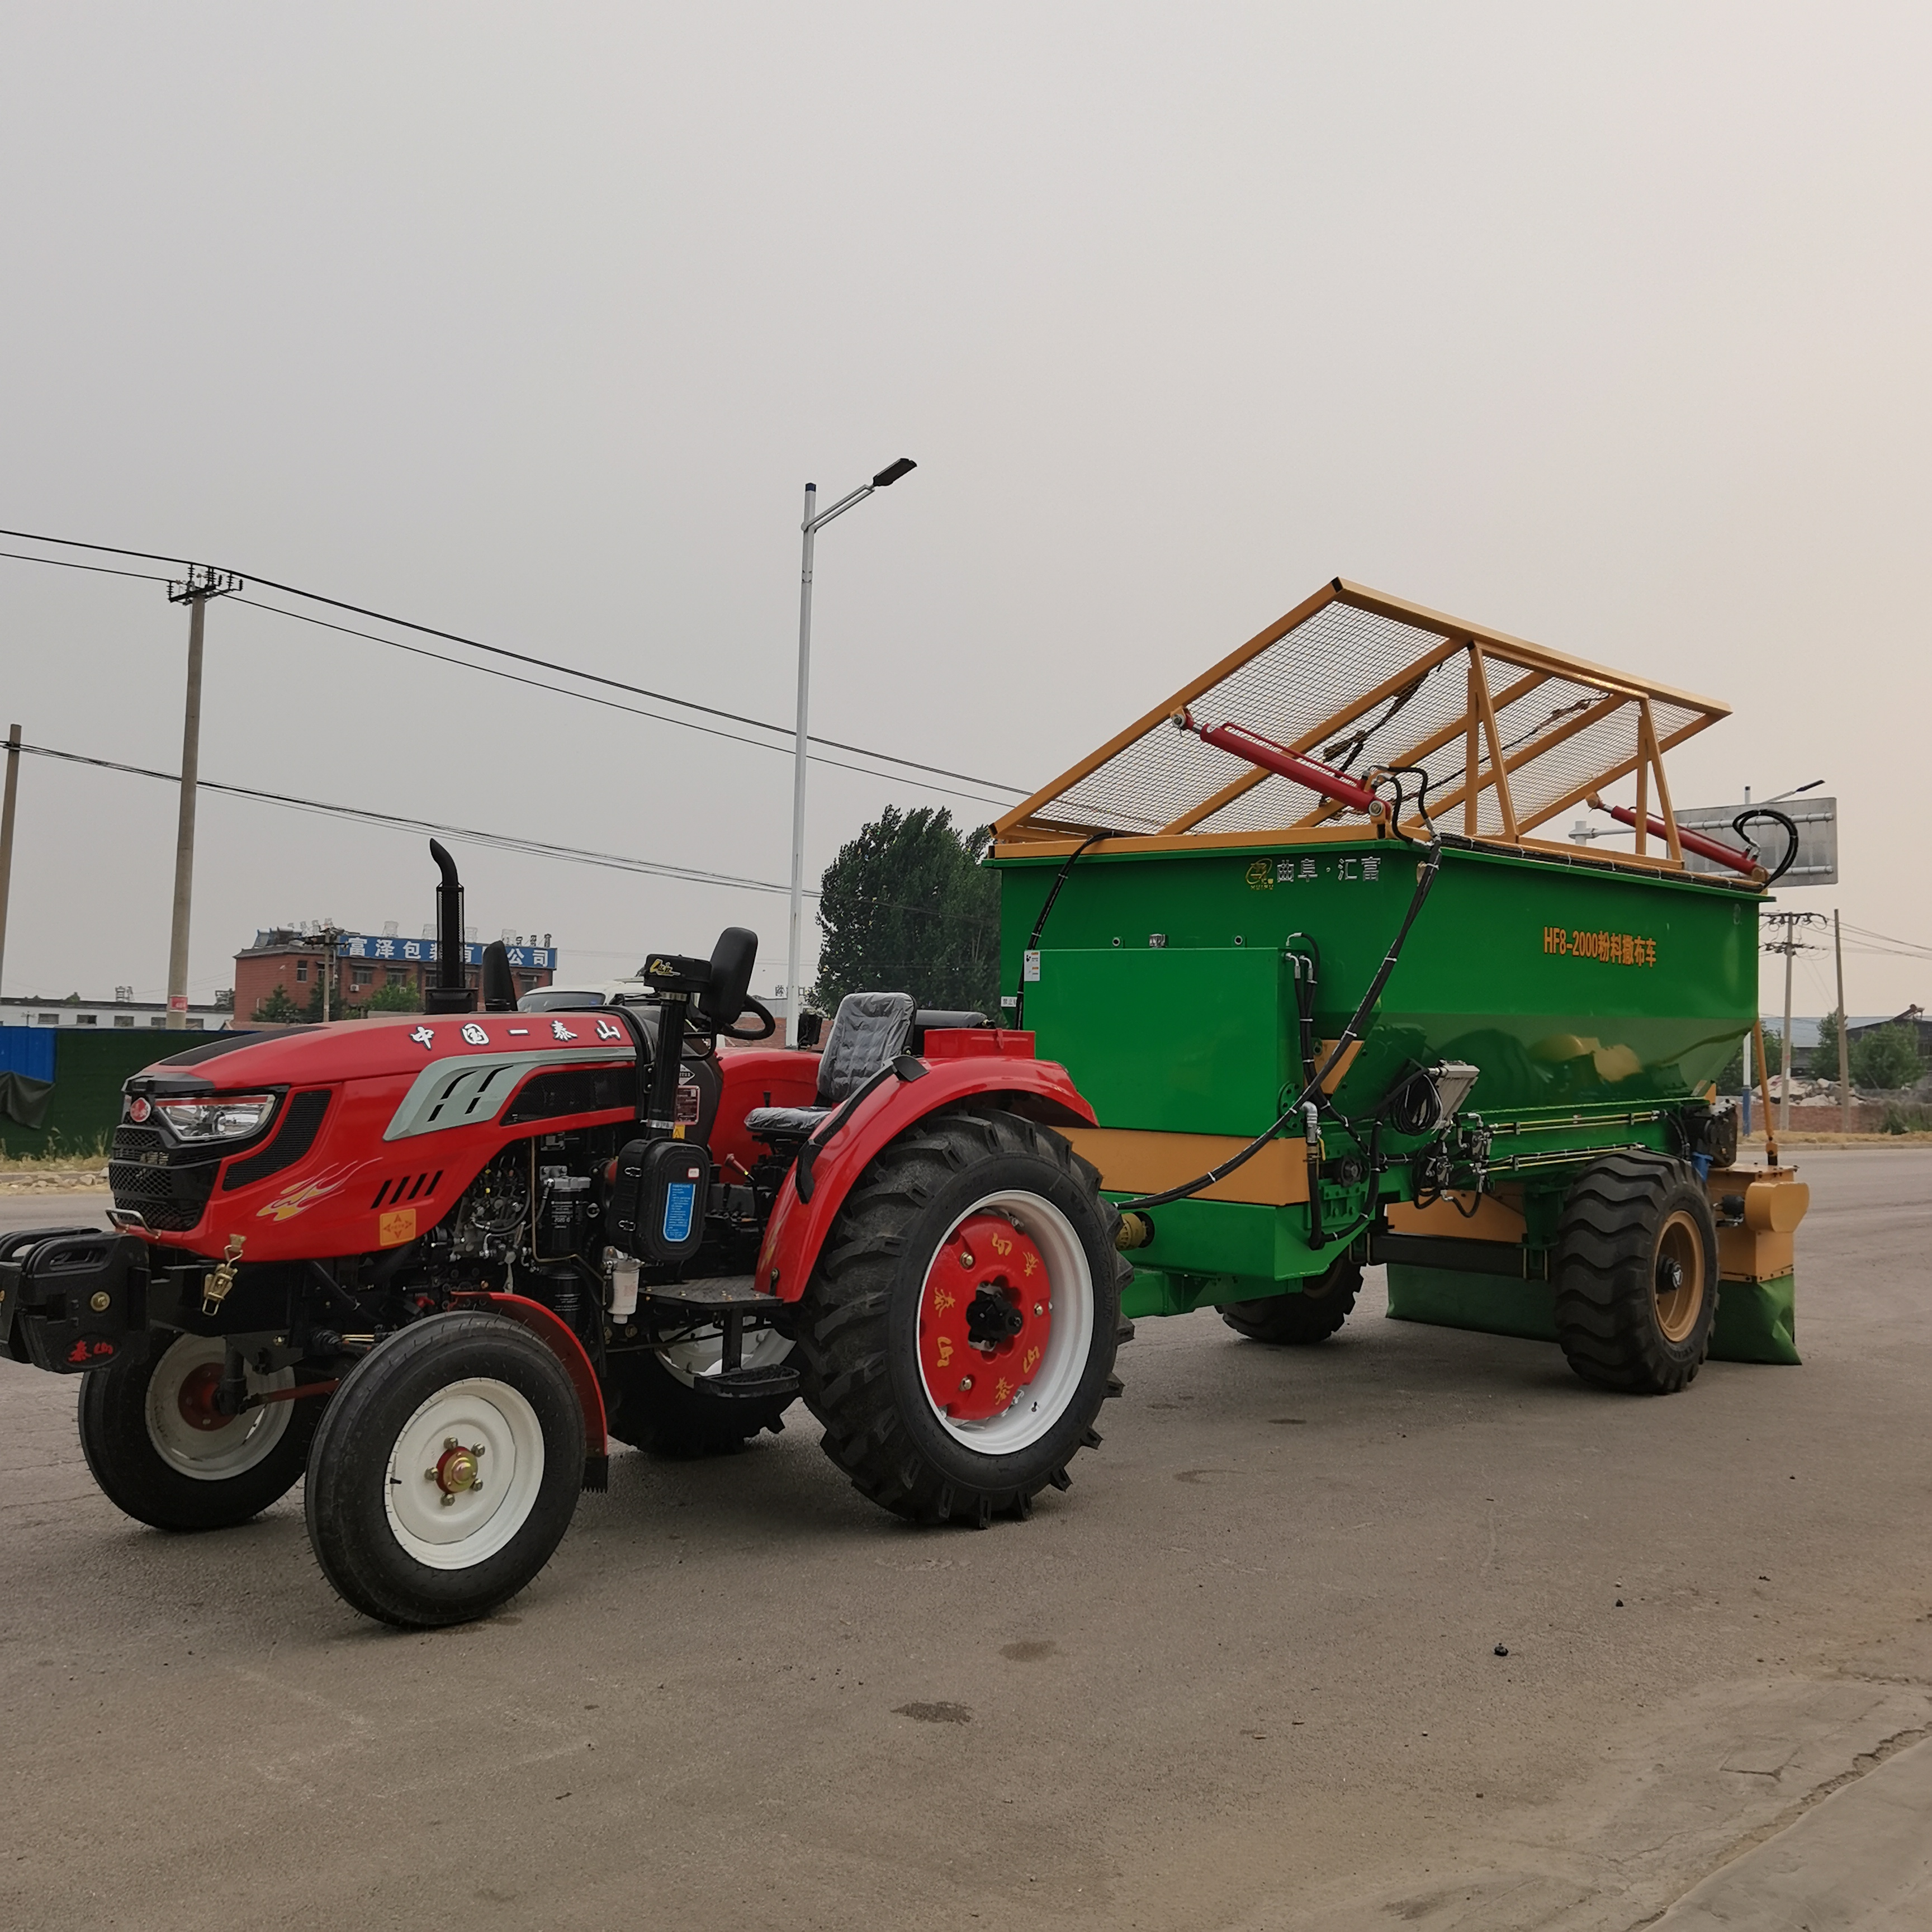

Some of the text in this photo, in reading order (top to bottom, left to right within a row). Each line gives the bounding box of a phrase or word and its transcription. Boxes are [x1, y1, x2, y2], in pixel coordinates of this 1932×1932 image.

[348, 937, 549, 967] 富泽包装有公司
[1543, 926, 1656, 968] HF8-2000粉料撒布车
